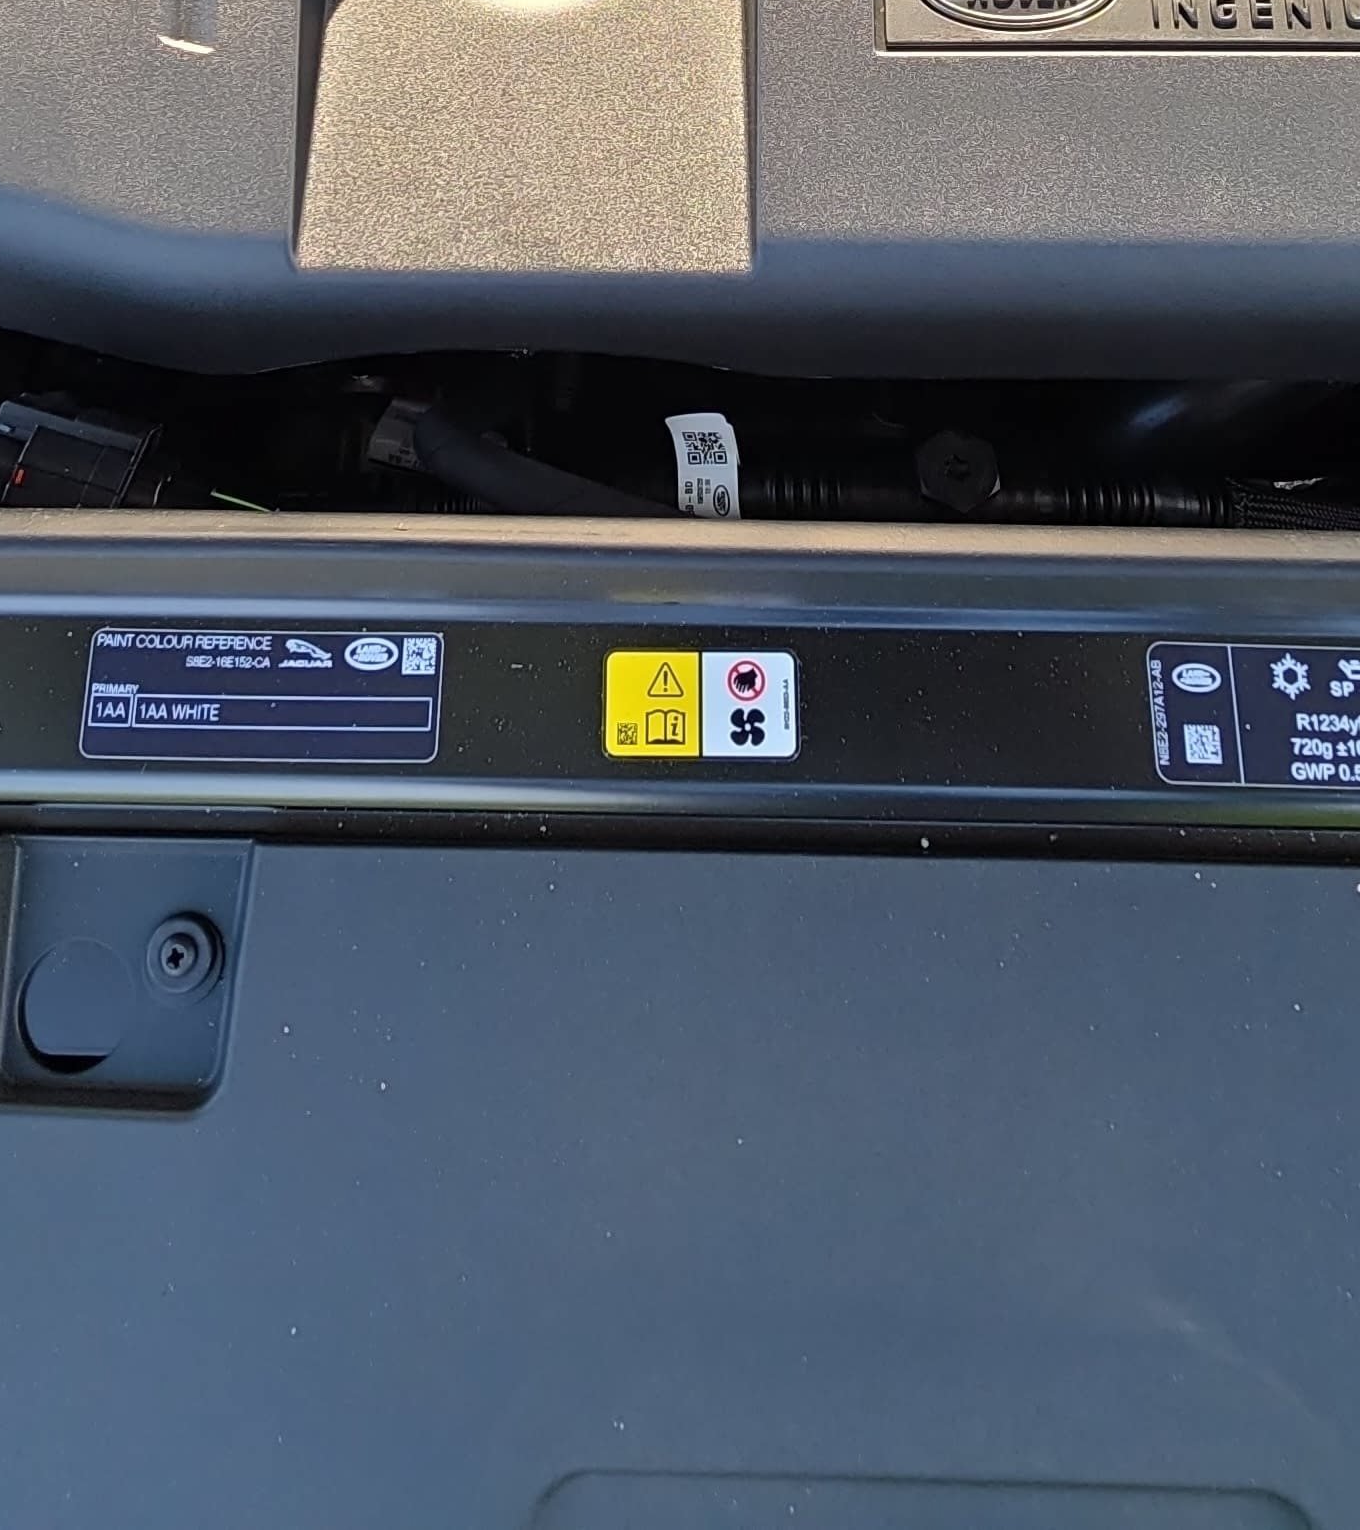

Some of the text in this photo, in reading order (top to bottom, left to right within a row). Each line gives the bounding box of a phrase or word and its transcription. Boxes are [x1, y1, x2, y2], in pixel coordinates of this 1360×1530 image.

[96, 633, 273, 650] PAINT COLOUR REFERENCE
[278, 659, 332, 668] JAGUAR
[92, 683, 139, 694] PRIMARY
[1330, 681, 1354, 697] SP
[96, 702, 126, 718] 1AA
[140, 703, 220, 721] 1AA WHITE
[1290, 738, 1333, 760] 720g
[1290, 762, 1335, 781] GWP
